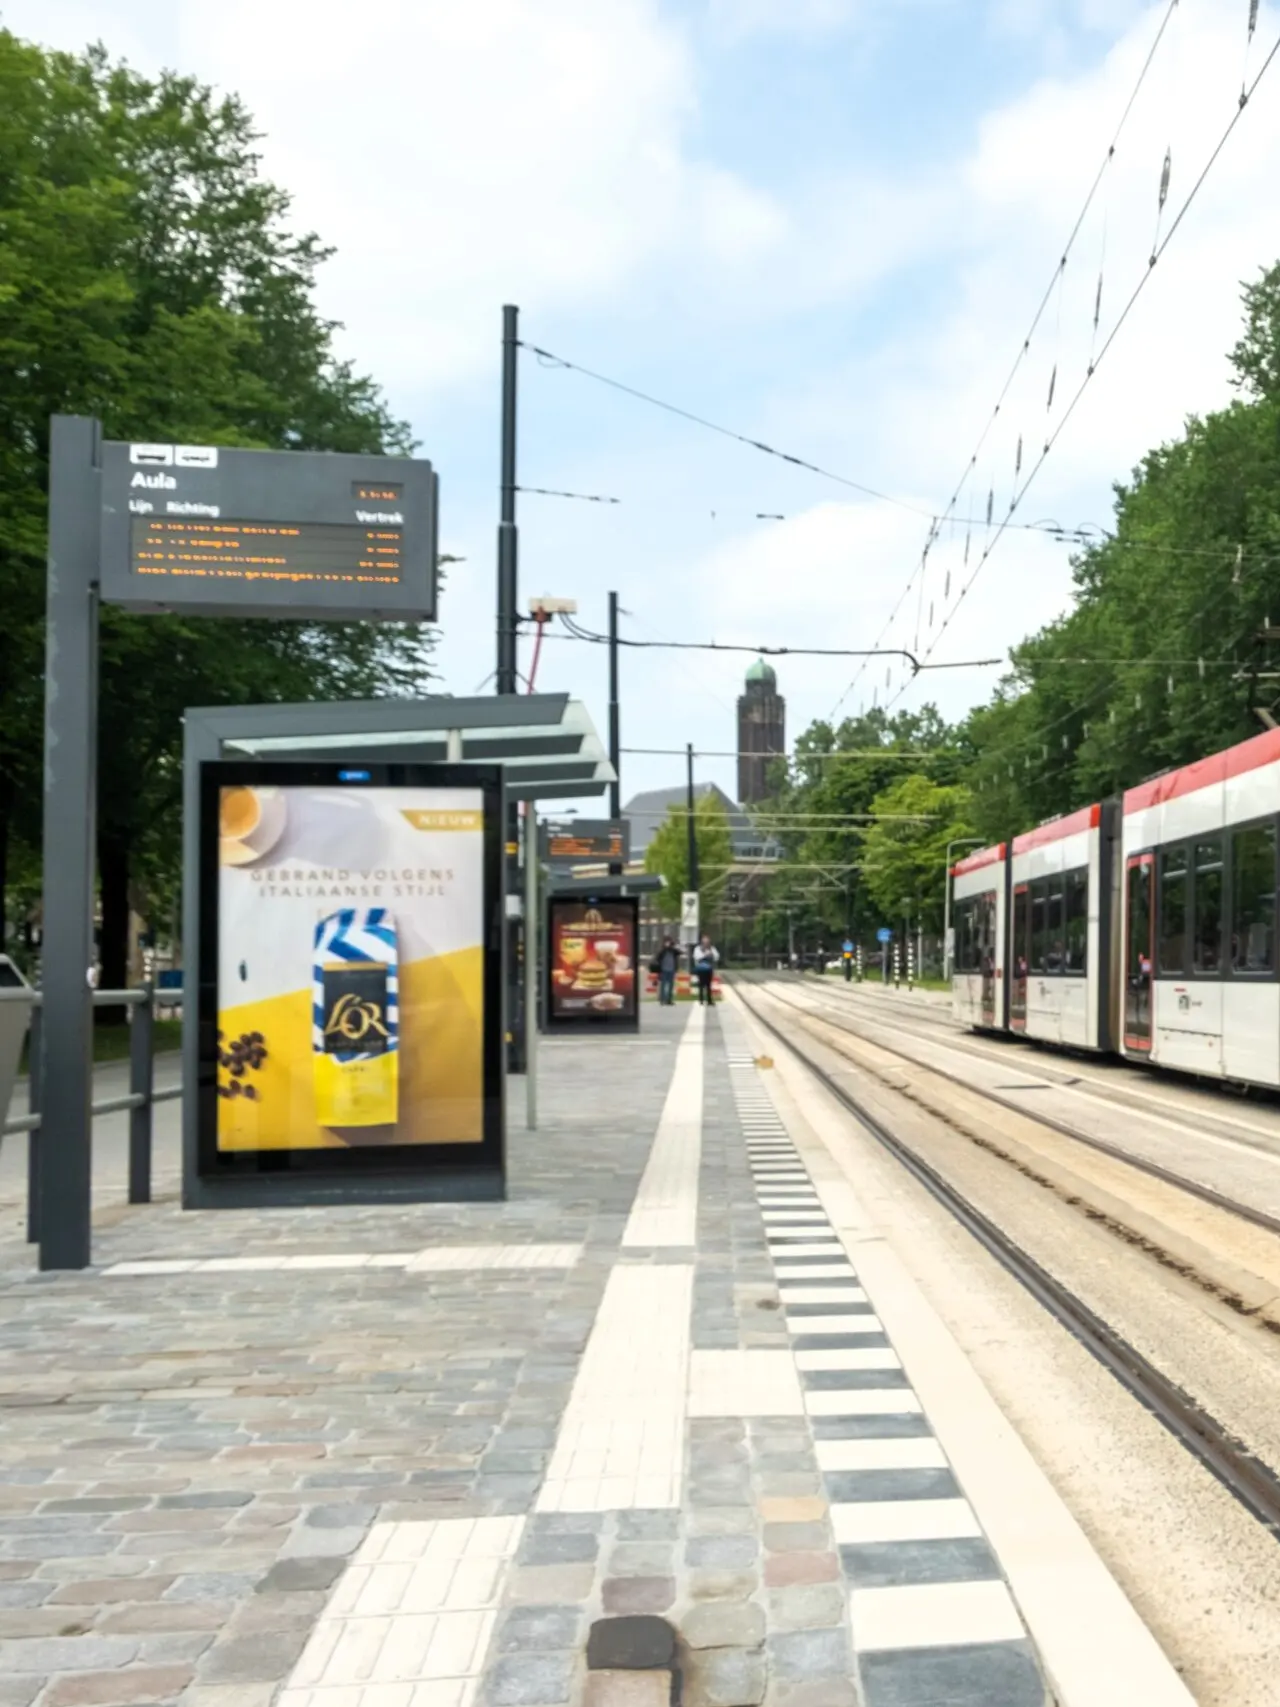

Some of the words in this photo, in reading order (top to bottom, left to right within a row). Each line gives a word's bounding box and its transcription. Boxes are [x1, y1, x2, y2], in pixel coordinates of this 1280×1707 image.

[130, 471, 177, 490] Aula
[129, 499, 153, 514] Lijn
[166, 501, 220, 519] Richting
[355, 510, 404, 525] Vertrek
[419, 814, 476, 826] NIEUW
[251, 869, 350, 881] GEBRAND
[361, 869, 455, 881] VOLGENS
[259, 886, 383, 897] ITALIAANSE
[394, 886, 446, 896] STIJL
